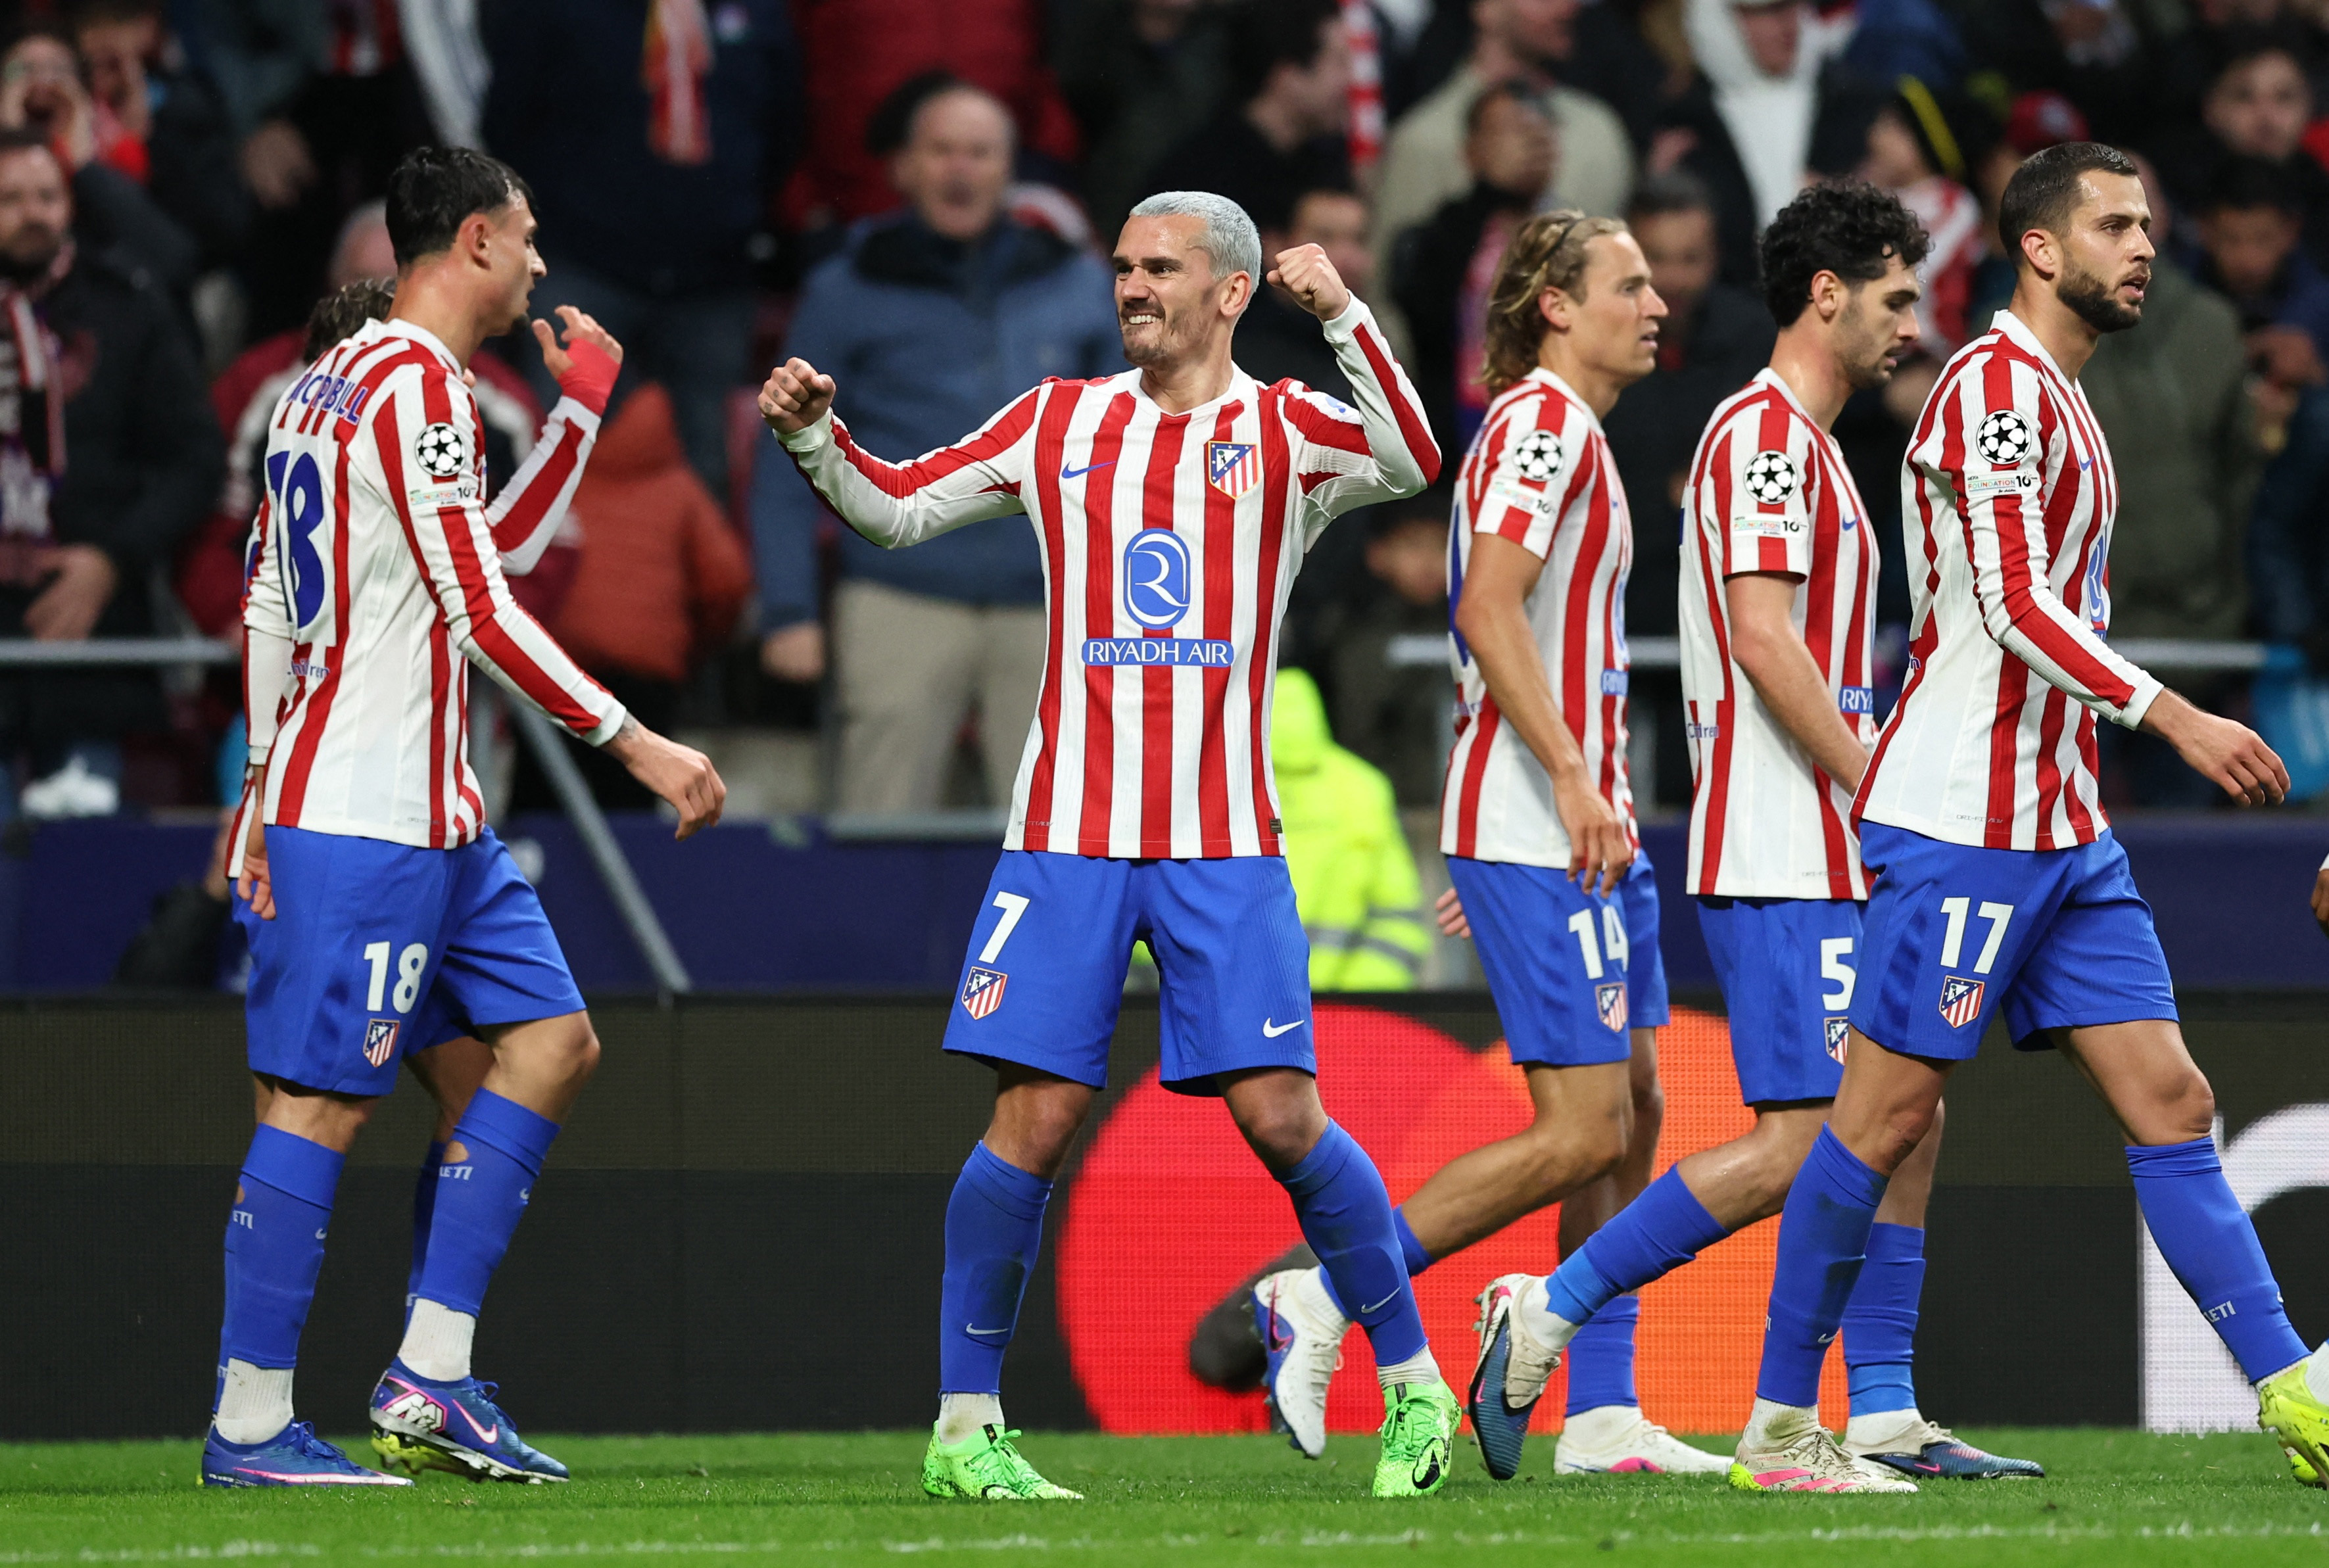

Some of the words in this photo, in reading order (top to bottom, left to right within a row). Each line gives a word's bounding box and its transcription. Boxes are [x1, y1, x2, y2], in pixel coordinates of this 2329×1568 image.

[1968, 479, 2015, 490] FOUNDATION
[2016, 475, 2031, 487] 10
[1089, 641, 1179, 662] RIYADH
[1188, 642, 1228, 664] AIR
[978, 890, 1031, 964] 7
[1568, 905, 1629, 980] 14
[1940, 897, 2015, 974] 17
[364, 941, 428, 1014] 18
[1820, 936, 1857, 1011] 5
